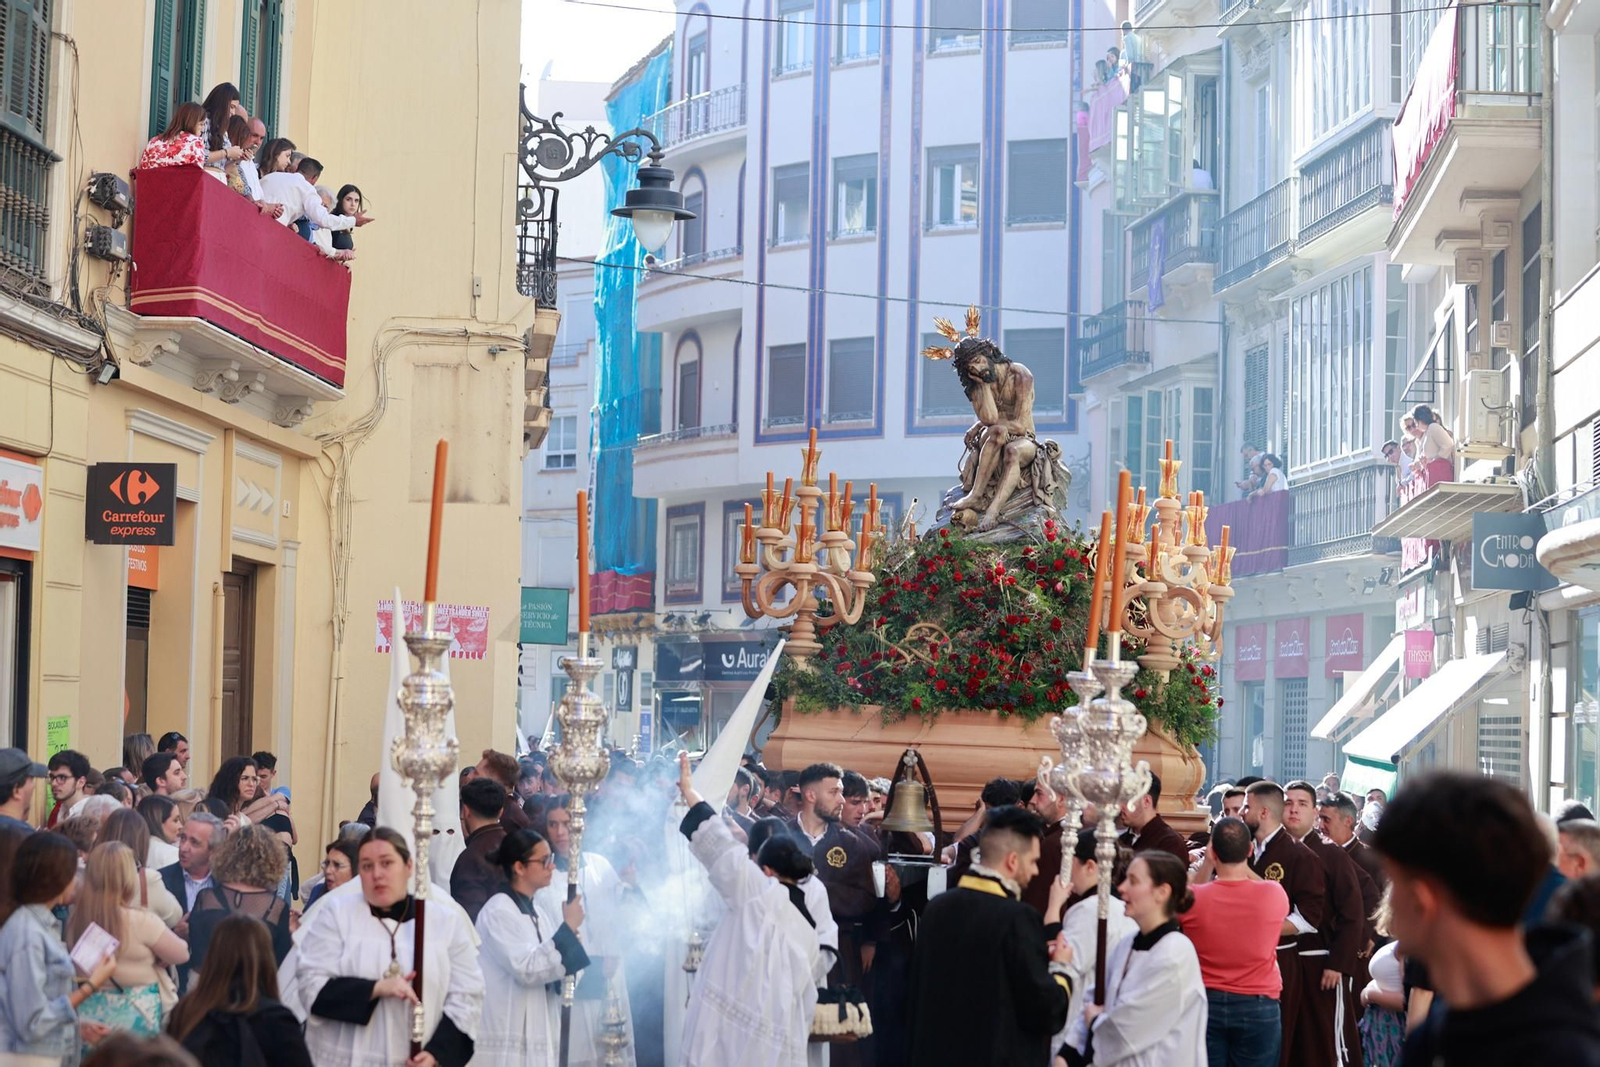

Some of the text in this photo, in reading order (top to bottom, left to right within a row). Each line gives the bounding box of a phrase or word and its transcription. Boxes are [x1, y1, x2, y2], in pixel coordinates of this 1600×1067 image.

[102, 510, 165, 523] Carrefour
[110, 526, 156, 538] express
[1496, 553, 1534, 569] MODA
[524, 620, 552, 629] TÉCNICA
